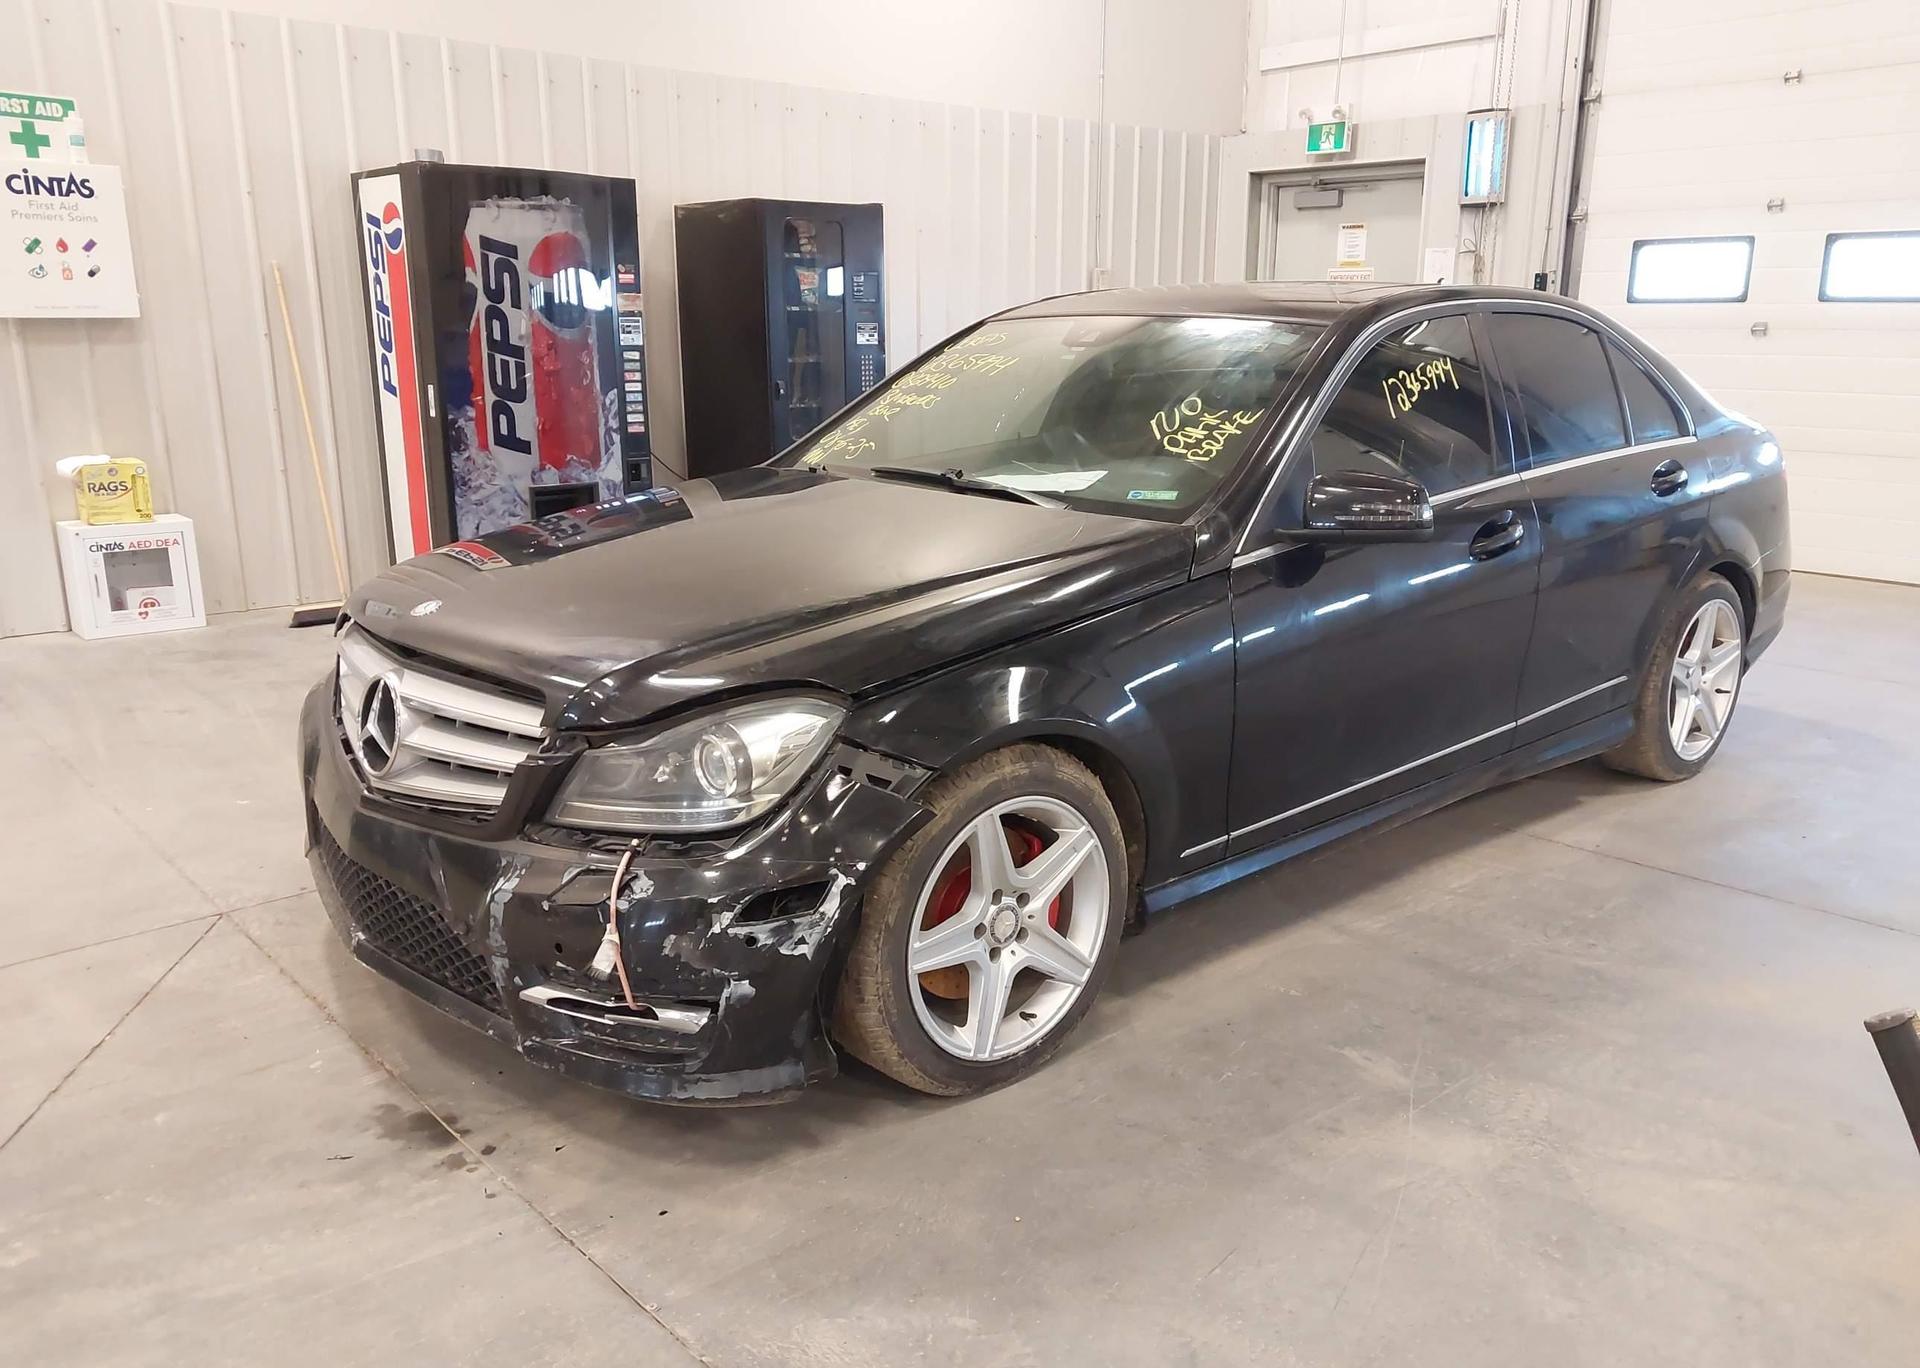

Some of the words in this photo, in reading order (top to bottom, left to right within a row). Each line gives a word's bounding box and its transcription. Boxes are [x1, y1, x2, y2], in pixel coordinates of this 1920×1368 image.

[35, 101, 64, 117] AID
[11, 209, 64, 221] Premiers
[67, 212, 98, 223] Soins
[28, 200, 55, 210] First
[59, 202, 79, 211] Aid
[366, 212, 398, 397] PEPSI
[479, 235, 531, 455] PEPSI
[1382, 356, 1460, 419] 12365994
[1150, 397, 1202, 440] NO
[1163, 409, 1229, 454] PARK
[1187, 408, 1266, 461] BRAKE
[87, 481, 128, 493] RAGS
[128, 541, 152, 550] AED
[156, 538, 180, 548] DEA
